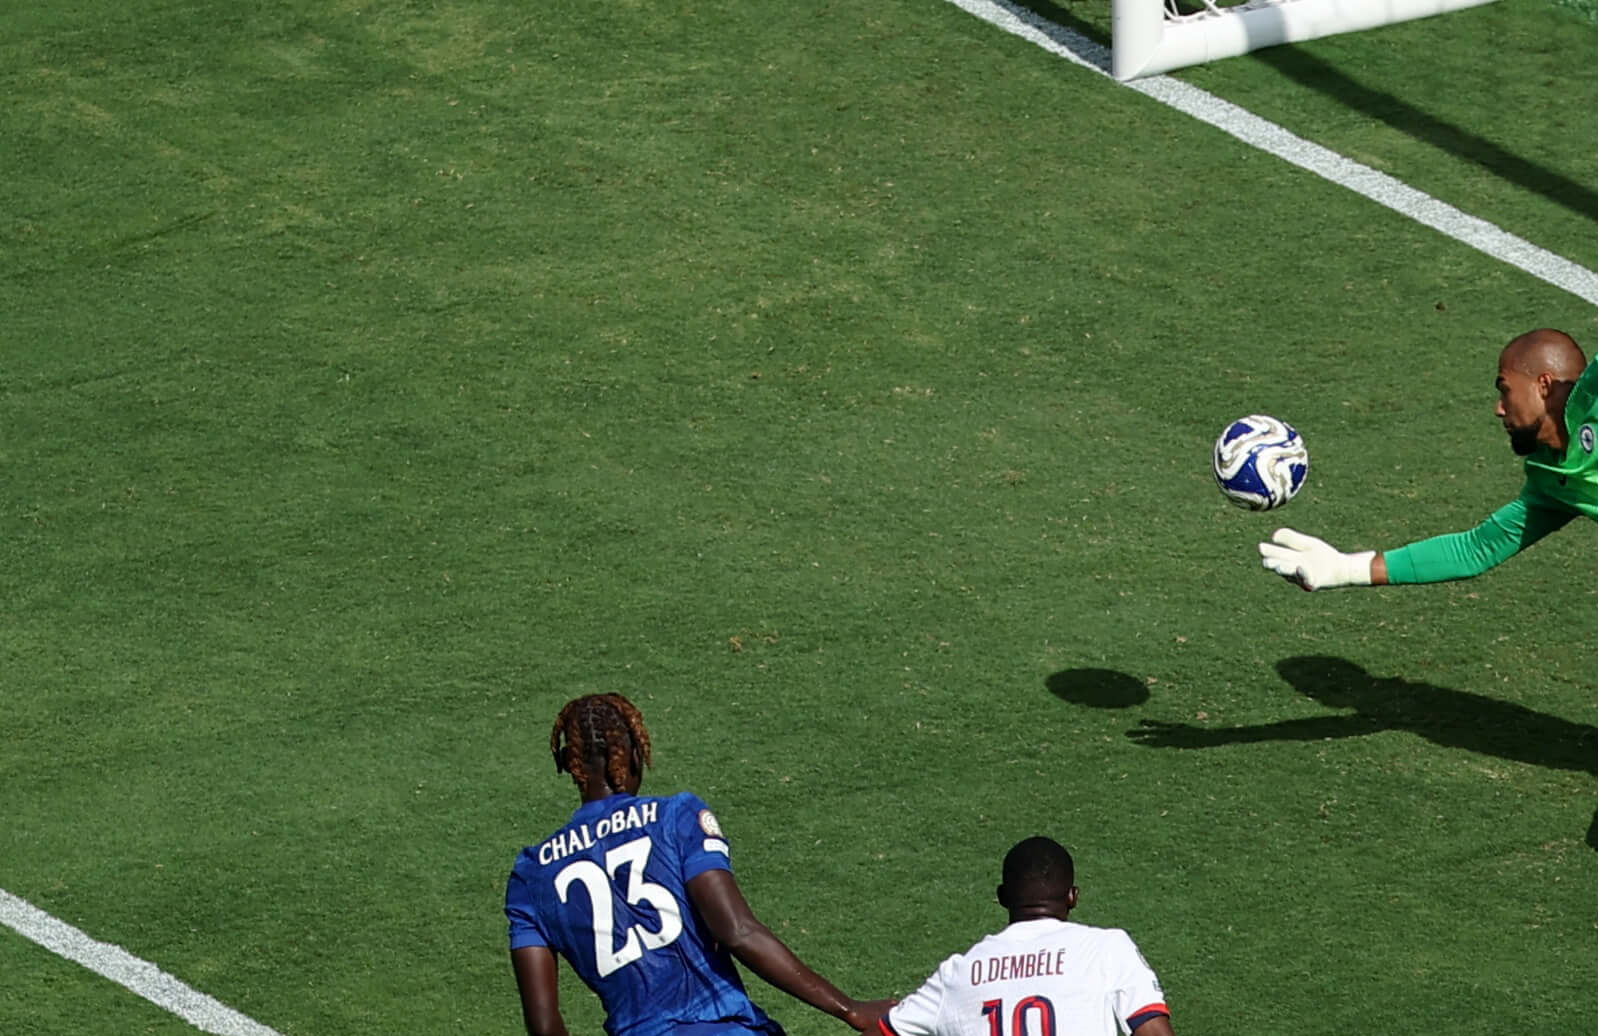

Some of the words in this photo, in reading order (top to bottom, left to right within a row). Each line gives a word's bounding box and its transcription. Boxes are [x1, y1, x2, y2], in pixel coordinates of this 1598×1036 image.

[538, 803, 659, 865] CHALOBAH
[555, 836, 683, 977] 23
[971, 948, 1066, 986] O.DEMBÉLÉ
